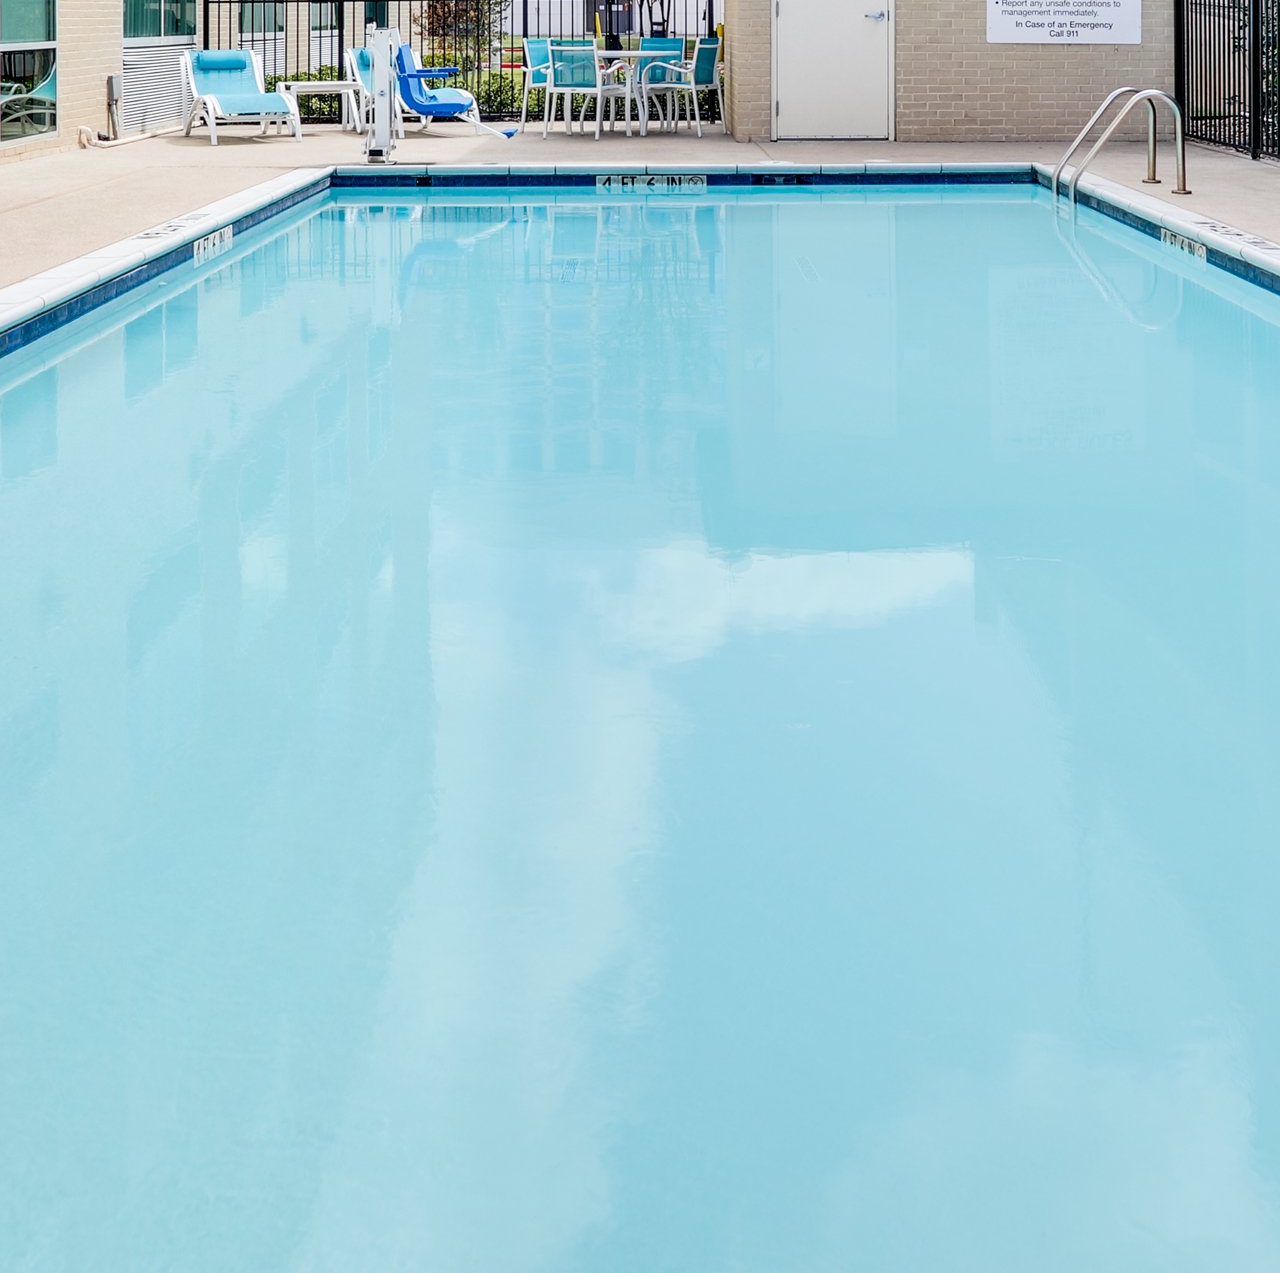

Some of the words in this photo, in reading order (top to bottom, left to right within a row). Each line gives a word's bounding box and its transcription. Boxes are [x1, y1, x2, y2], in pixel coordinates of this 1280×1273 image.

[1001, 9, 1051, 17] management
[1053, 9, 1099, 18] immediately.
[1070, 21, 1113, 30] Emergency
